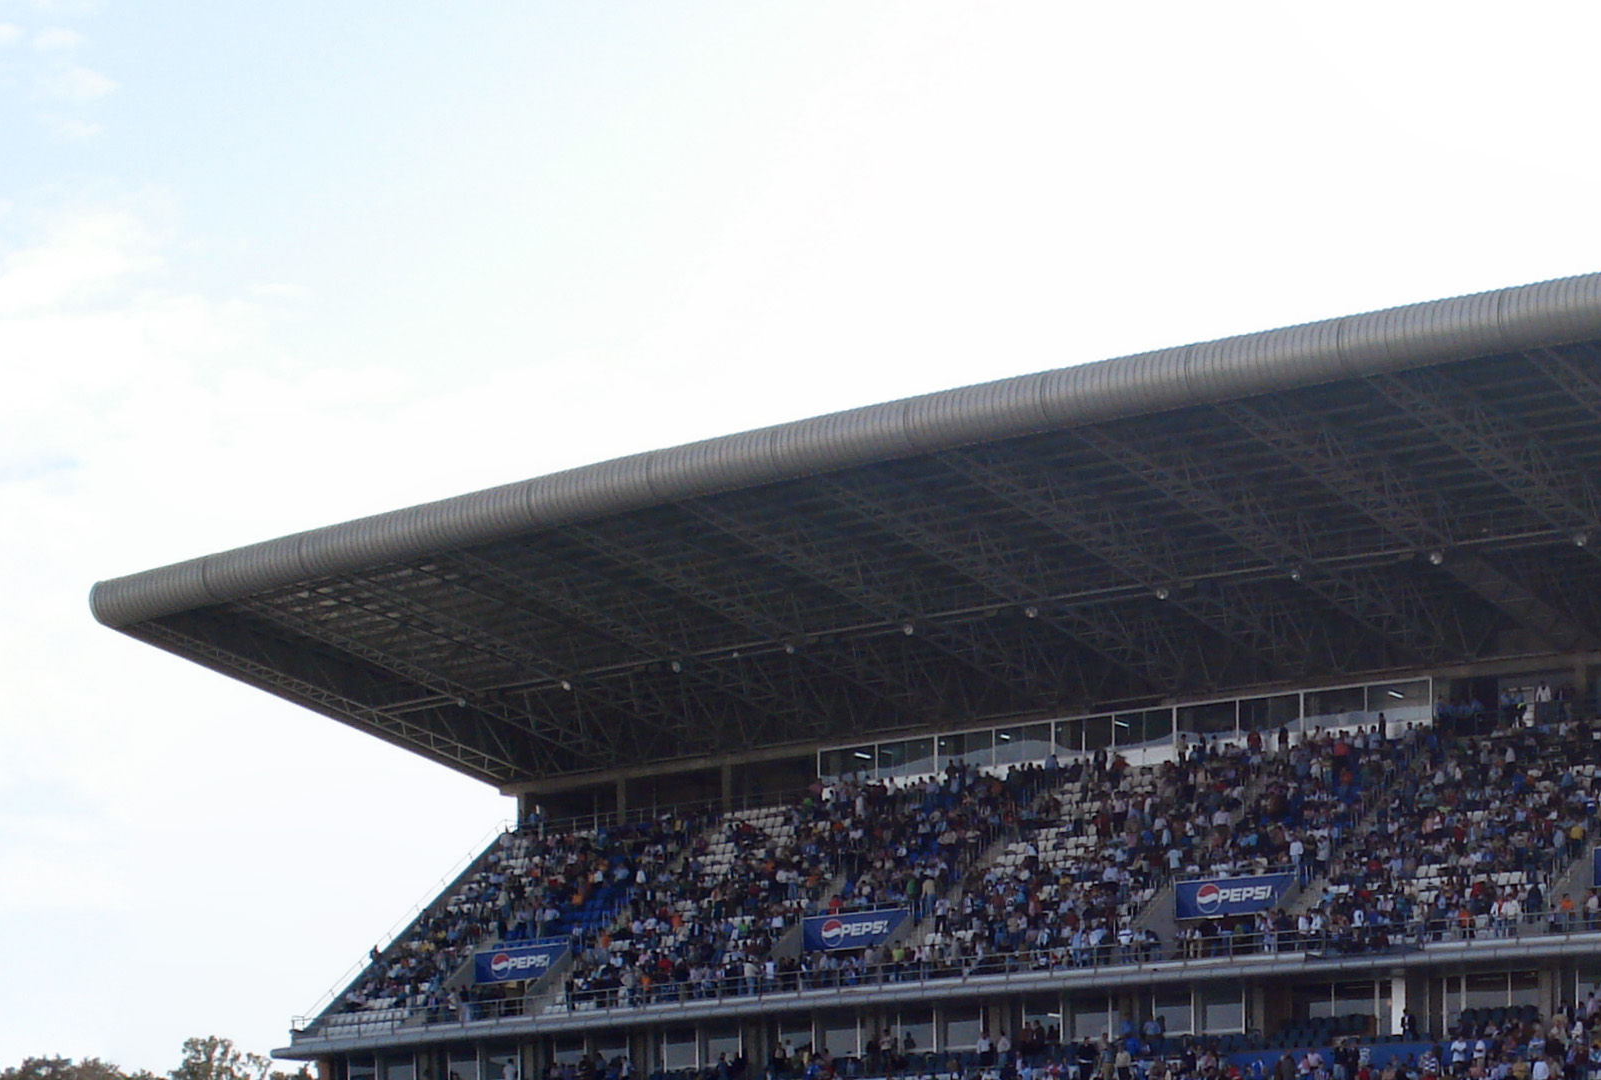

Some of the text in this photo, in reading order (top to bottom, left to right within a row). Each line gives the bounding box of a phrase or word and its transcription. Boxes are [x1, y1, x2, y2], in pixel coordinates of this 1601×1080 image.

[1216, 884, 1272, 903] PEPSI
[839, 918, 890, 937] PEPSI
[507, 953, 551, 970] PEPSI
